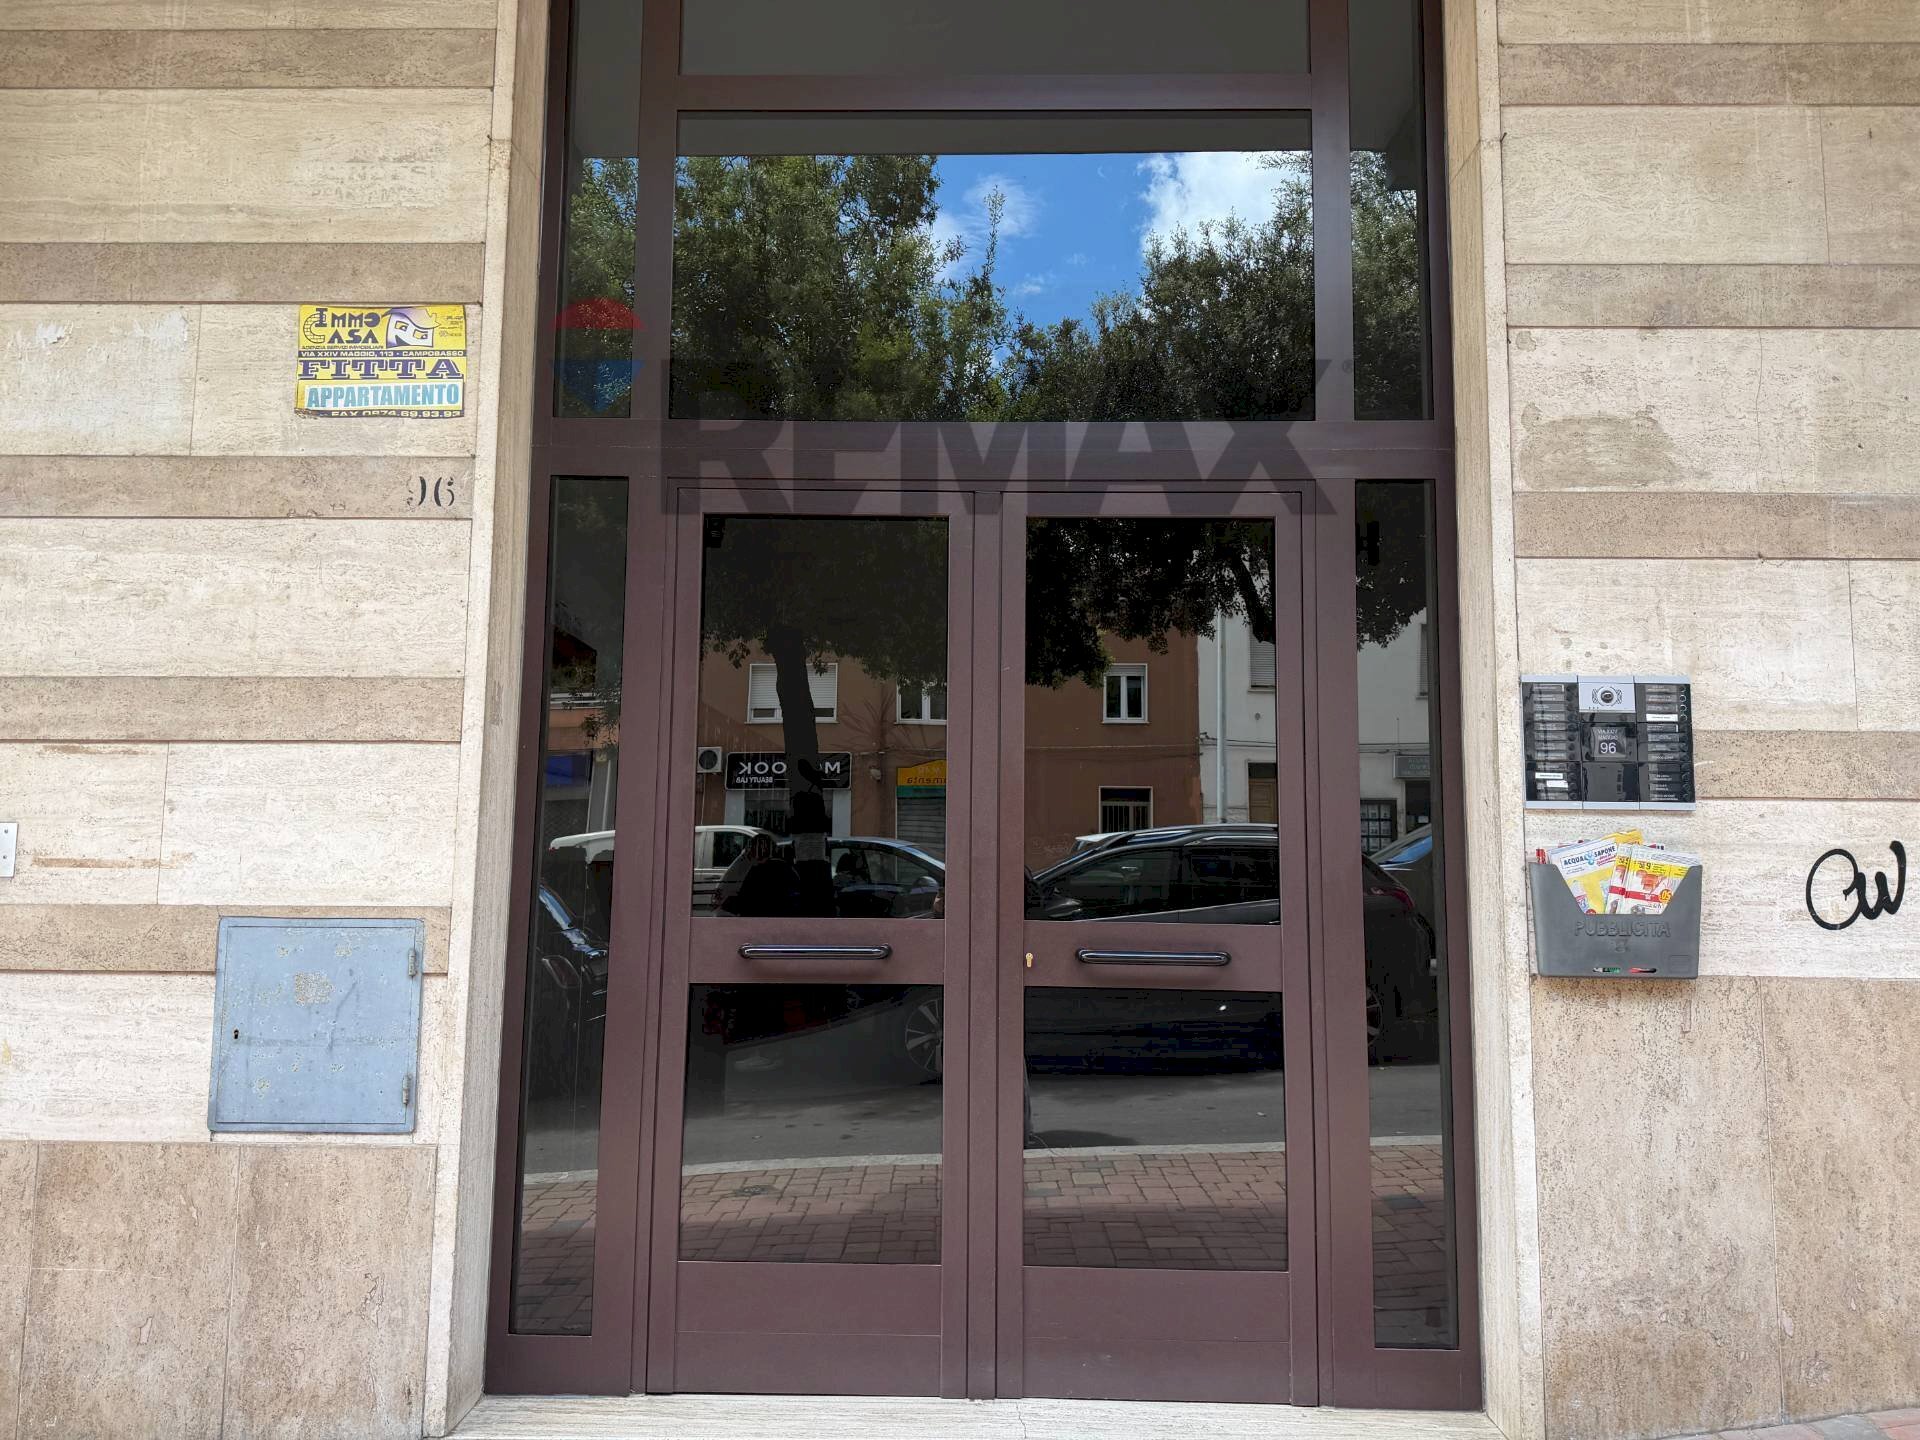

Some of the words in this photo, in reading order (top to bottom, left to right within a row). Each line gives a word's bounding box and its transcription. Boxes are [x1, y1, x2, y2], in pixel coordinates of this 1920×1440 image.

[315, 308, 380, 328] IMMO
[298, 359, 465, 379] FITTA
[306, 384, 460, 408] APPARTAMENTO
[1600, 742, 1617, 754] 96
[1563, 857, 1584, 866] ACQUA
[1594, 845, 1616, 858] SAPONE
